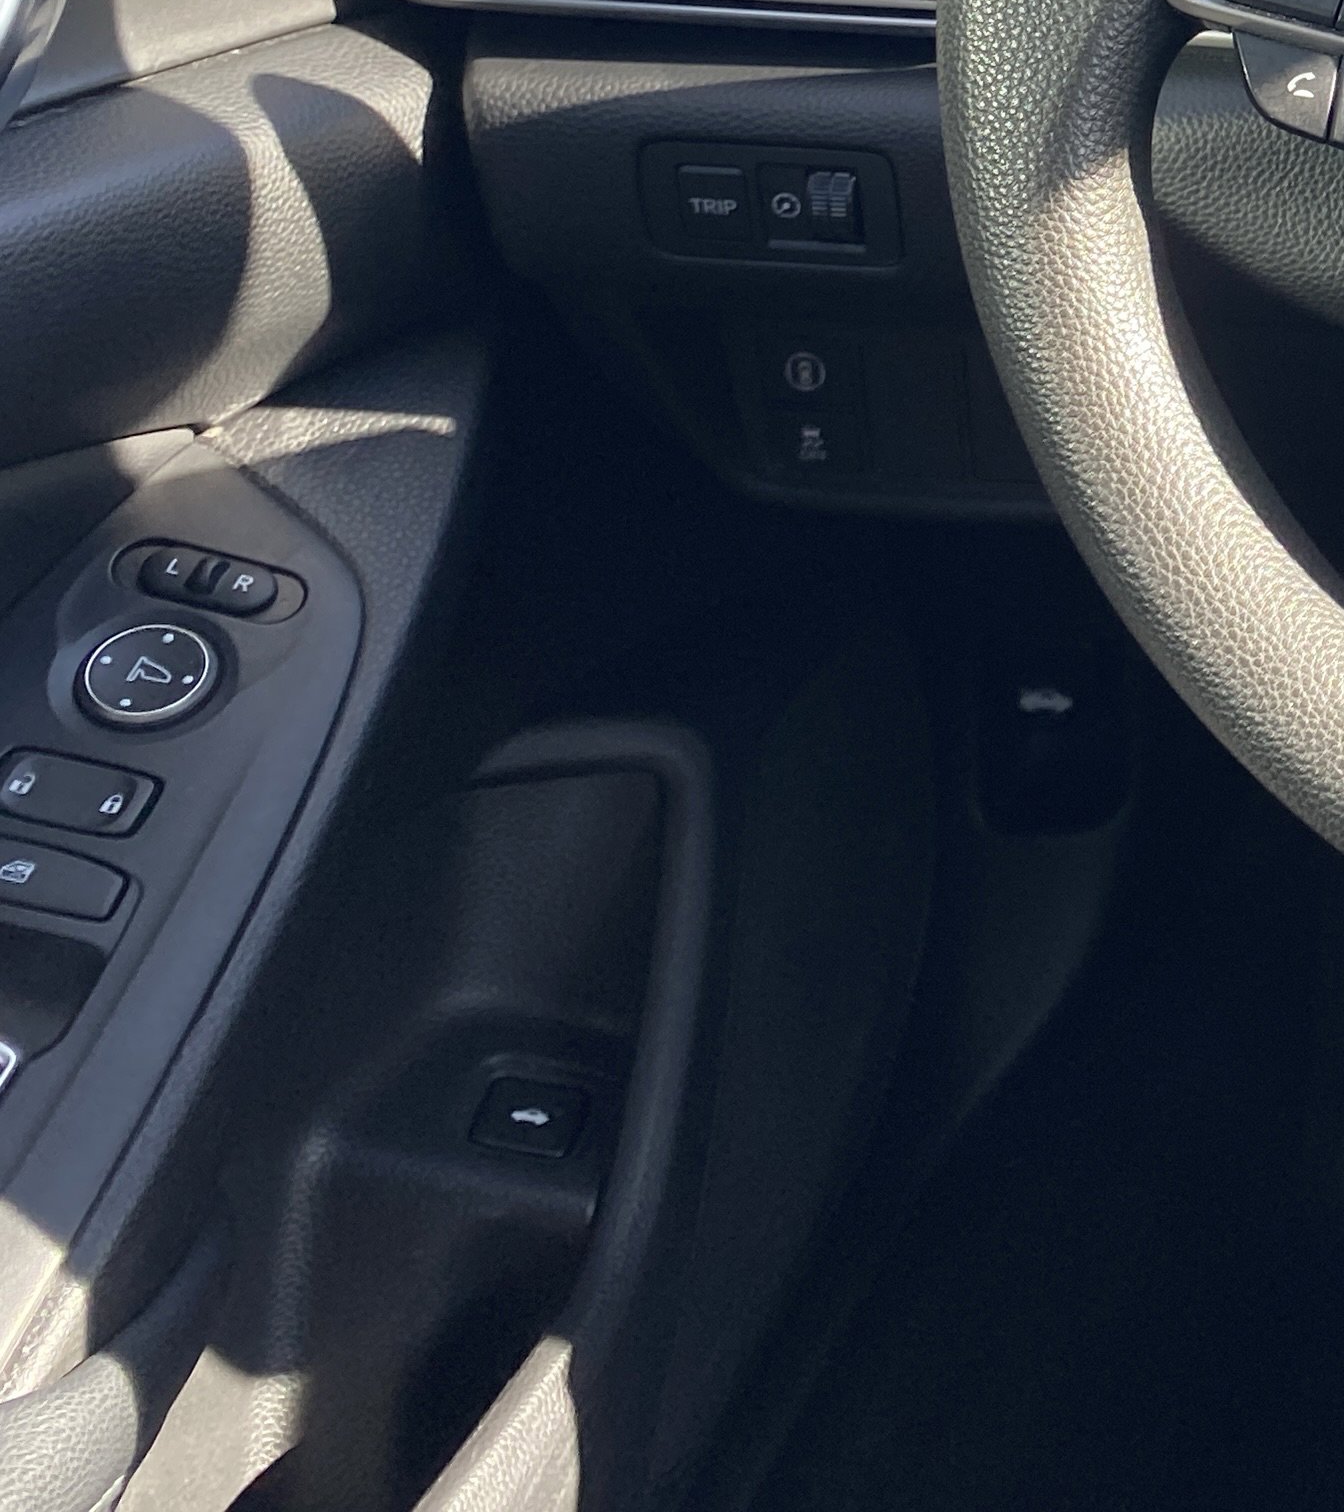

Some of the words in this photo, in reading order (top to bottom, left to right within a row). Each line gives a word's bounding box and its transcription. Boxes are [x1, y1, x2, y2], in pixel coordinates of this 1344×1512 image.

[689, 196, 737, 216] TRIP
[165, 557, 180, 577] L
[232, 573, 255, 594] R
